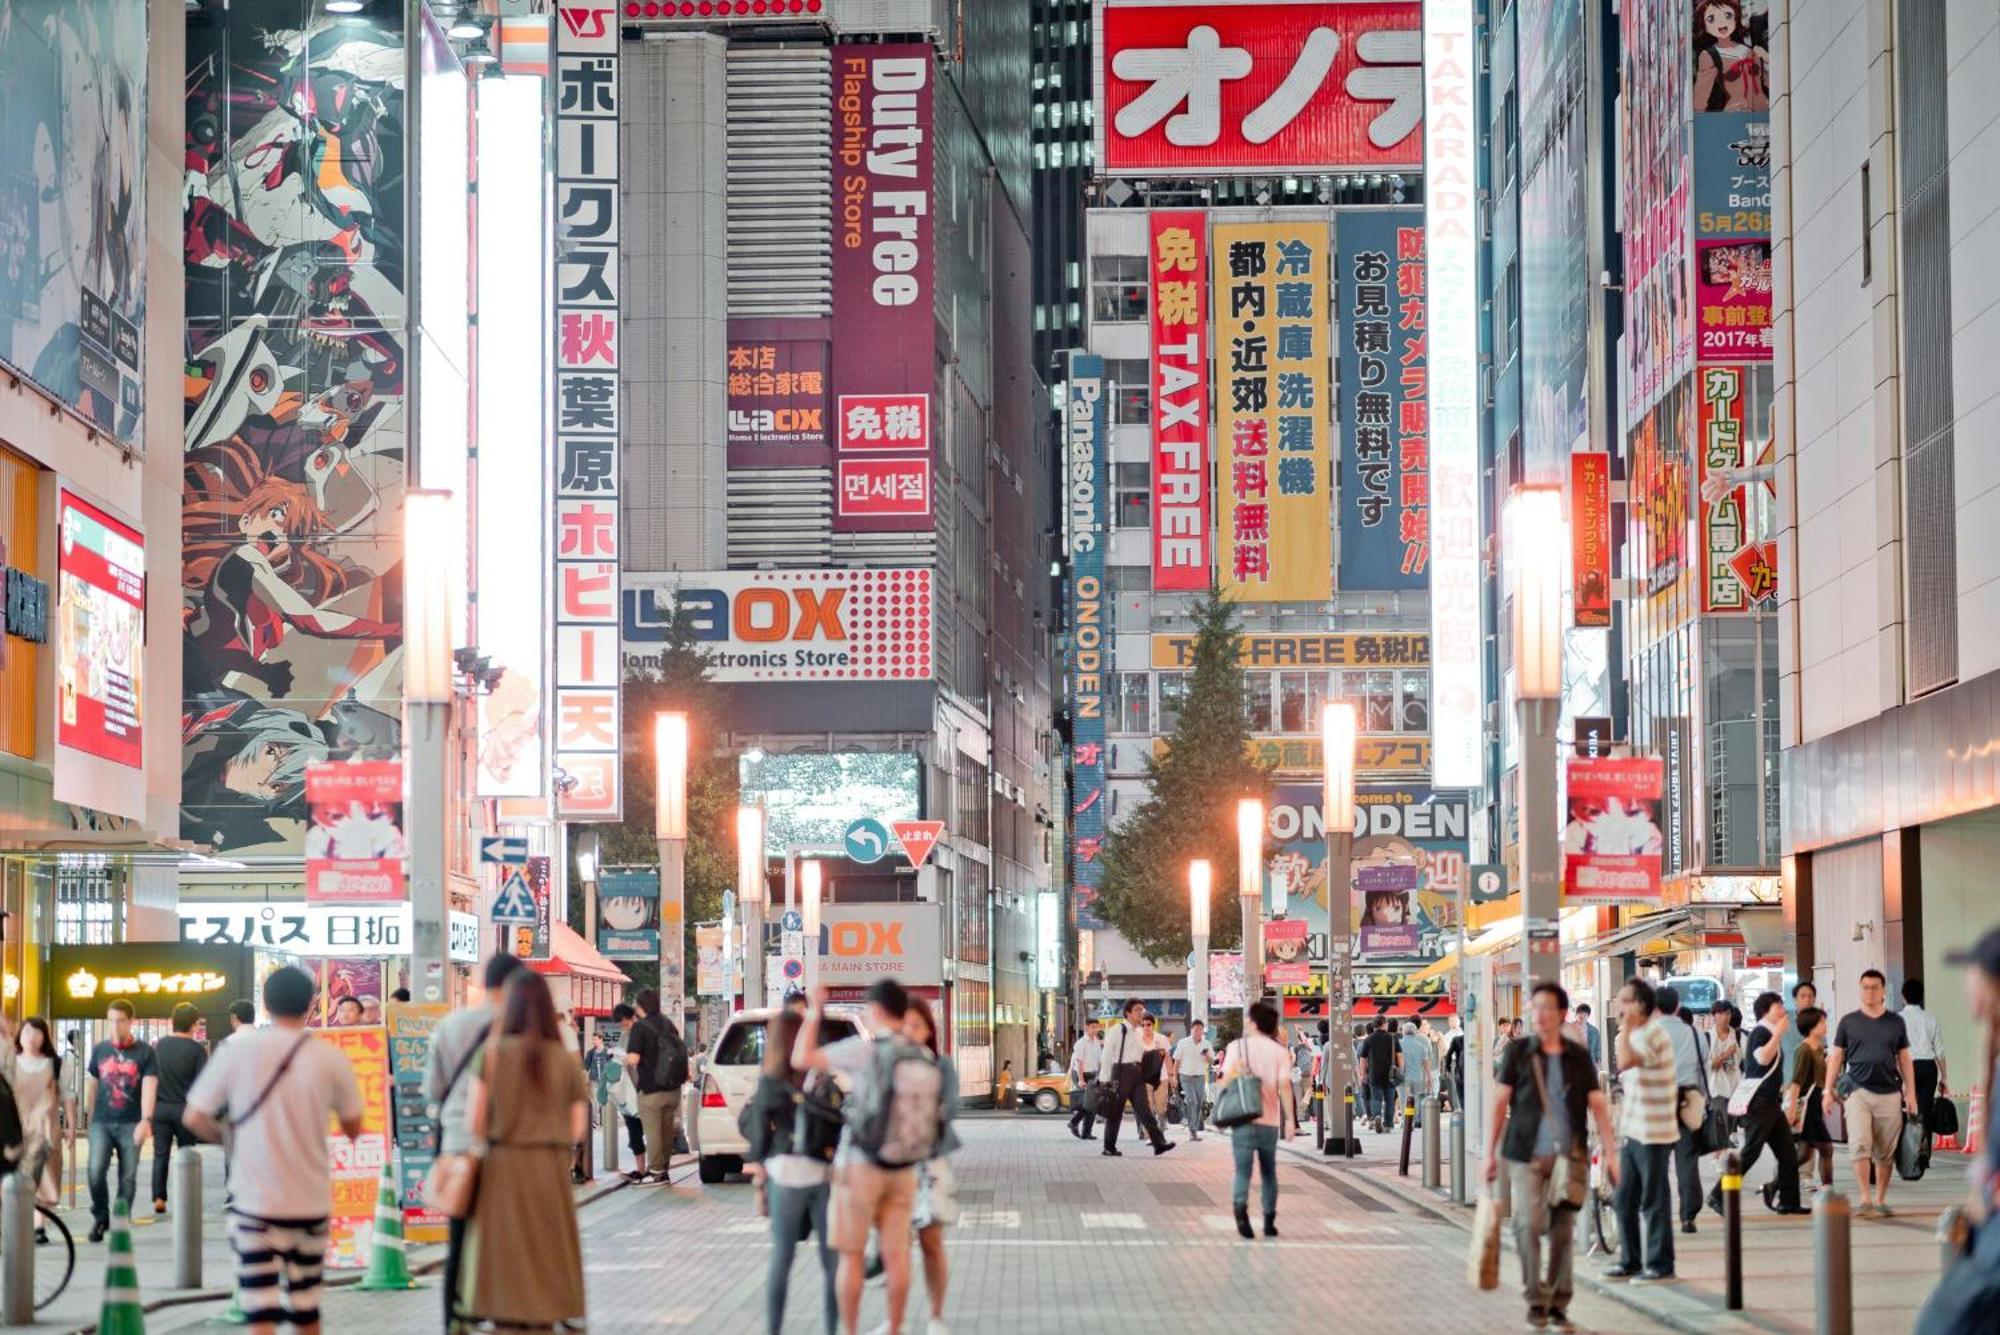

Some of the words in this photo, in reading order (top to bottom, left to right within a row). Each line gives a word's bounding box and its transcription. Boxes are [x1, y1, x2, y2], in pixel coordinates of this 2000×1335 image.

[839, 58, 866, 166] Flagship
[867, 58, 926, 178] Duty
[1431, 33, 1469, 238] TAKARADA
[844, 176, 867, 249] Store
[872, 190, 926, 307] Free
[1156, 228, 1199, 326] 免税
[1702, 305, 1773, 327] 事前登
[729, 346, 776, 370] 本店
[728, 371, 823, 396] 総合家電
[1159, 333, 1201, 430] TAX
[1352, 252, 1392, 528] お見積り無料です
[801, 432, 824, 441] Store
[846, 405, 921, 441] 免税
[1071, 377, 1102, 554] Panasonic
[845, 473, 923, 501] 면세점
[1160, 441, 1203, 569] FREE
[623, 651, 662, 668] om
[700, 650, 788, 668] ctronics
[795, 649, 849, 667] Store
[1076, 575, 1100, 718] ONODEN
[1252, 638, 1345, 664] FREE
[1355, 742, 1430, 768] エアコ
[1395, 791, 1413, 805] to
[902, 830, 933, 842] 止まれ
[832, 962, 861, 972] MAIN
[865, 962, 905, 972] STORE
